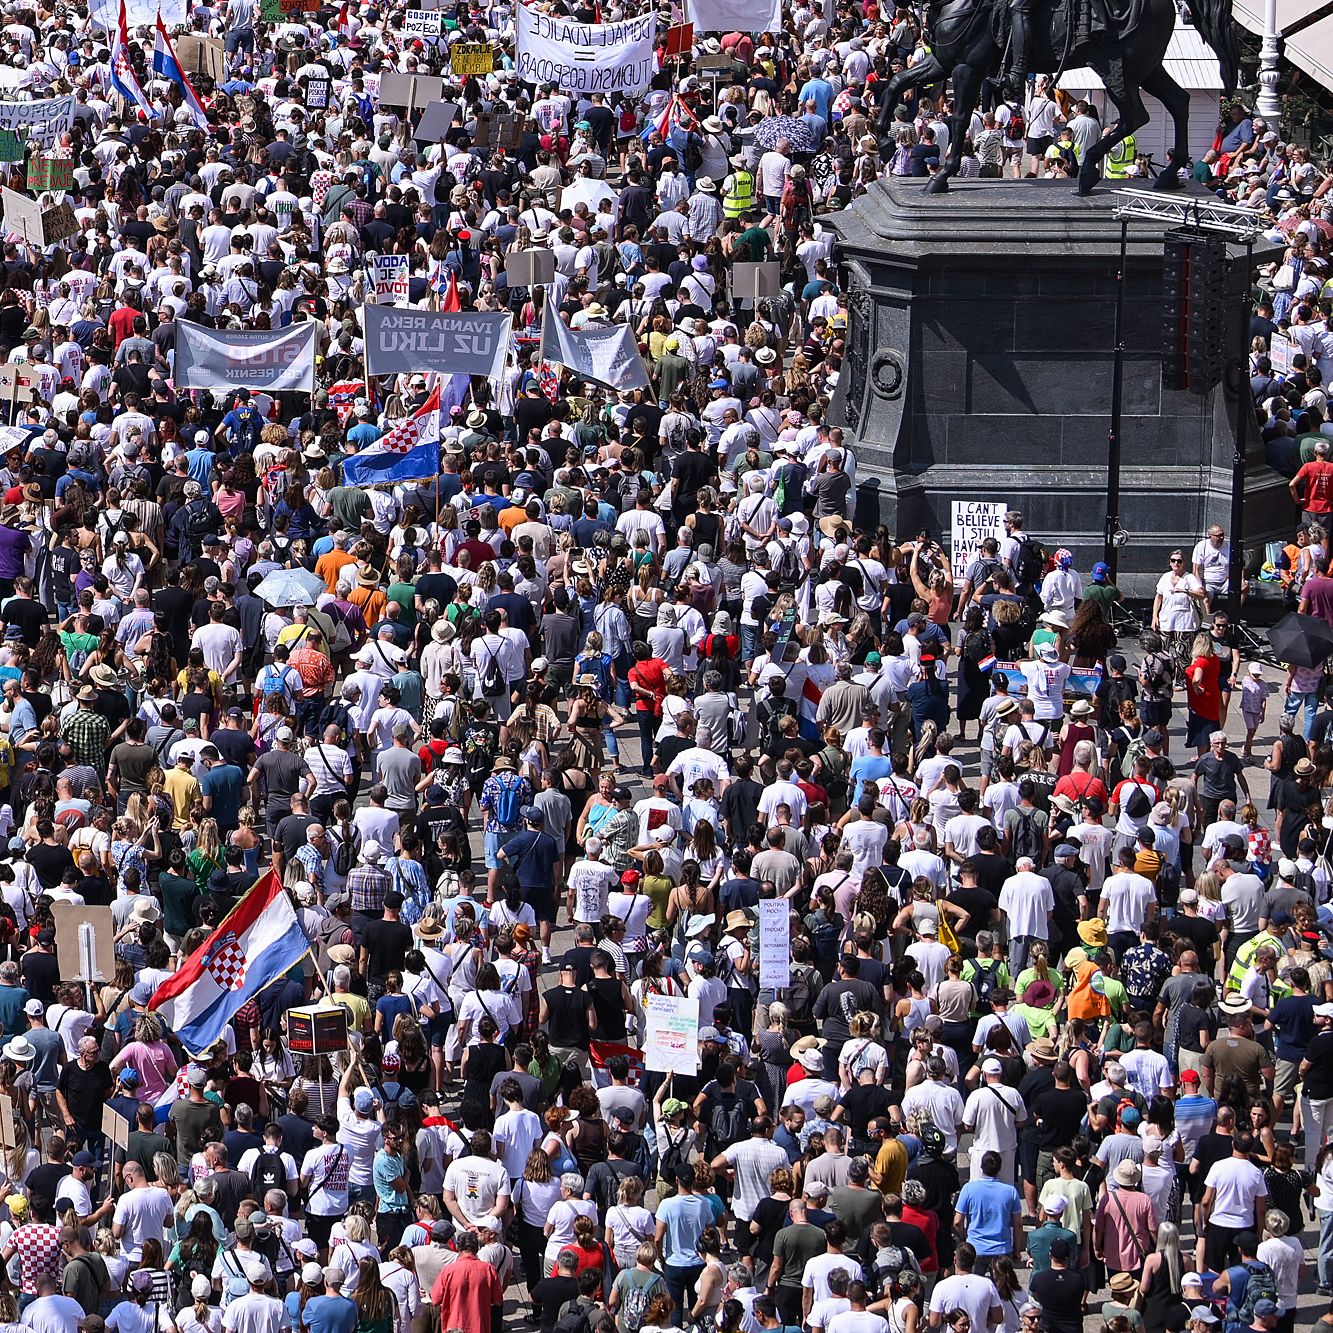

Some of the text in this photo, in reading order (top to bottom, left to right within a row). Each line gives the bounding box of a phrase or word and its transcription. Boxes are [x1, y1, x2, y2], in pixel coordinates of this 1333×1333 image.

[30, 160, 75, 174] NEMA
[27, 174, 74, 189] PREDAJE
[374, 256, 409, 269] VODA
[380, 268, 396, 280] JE
[966, 502, 999, 514] CAN'T
[956, 513, 1000, 528] BELIEVE
